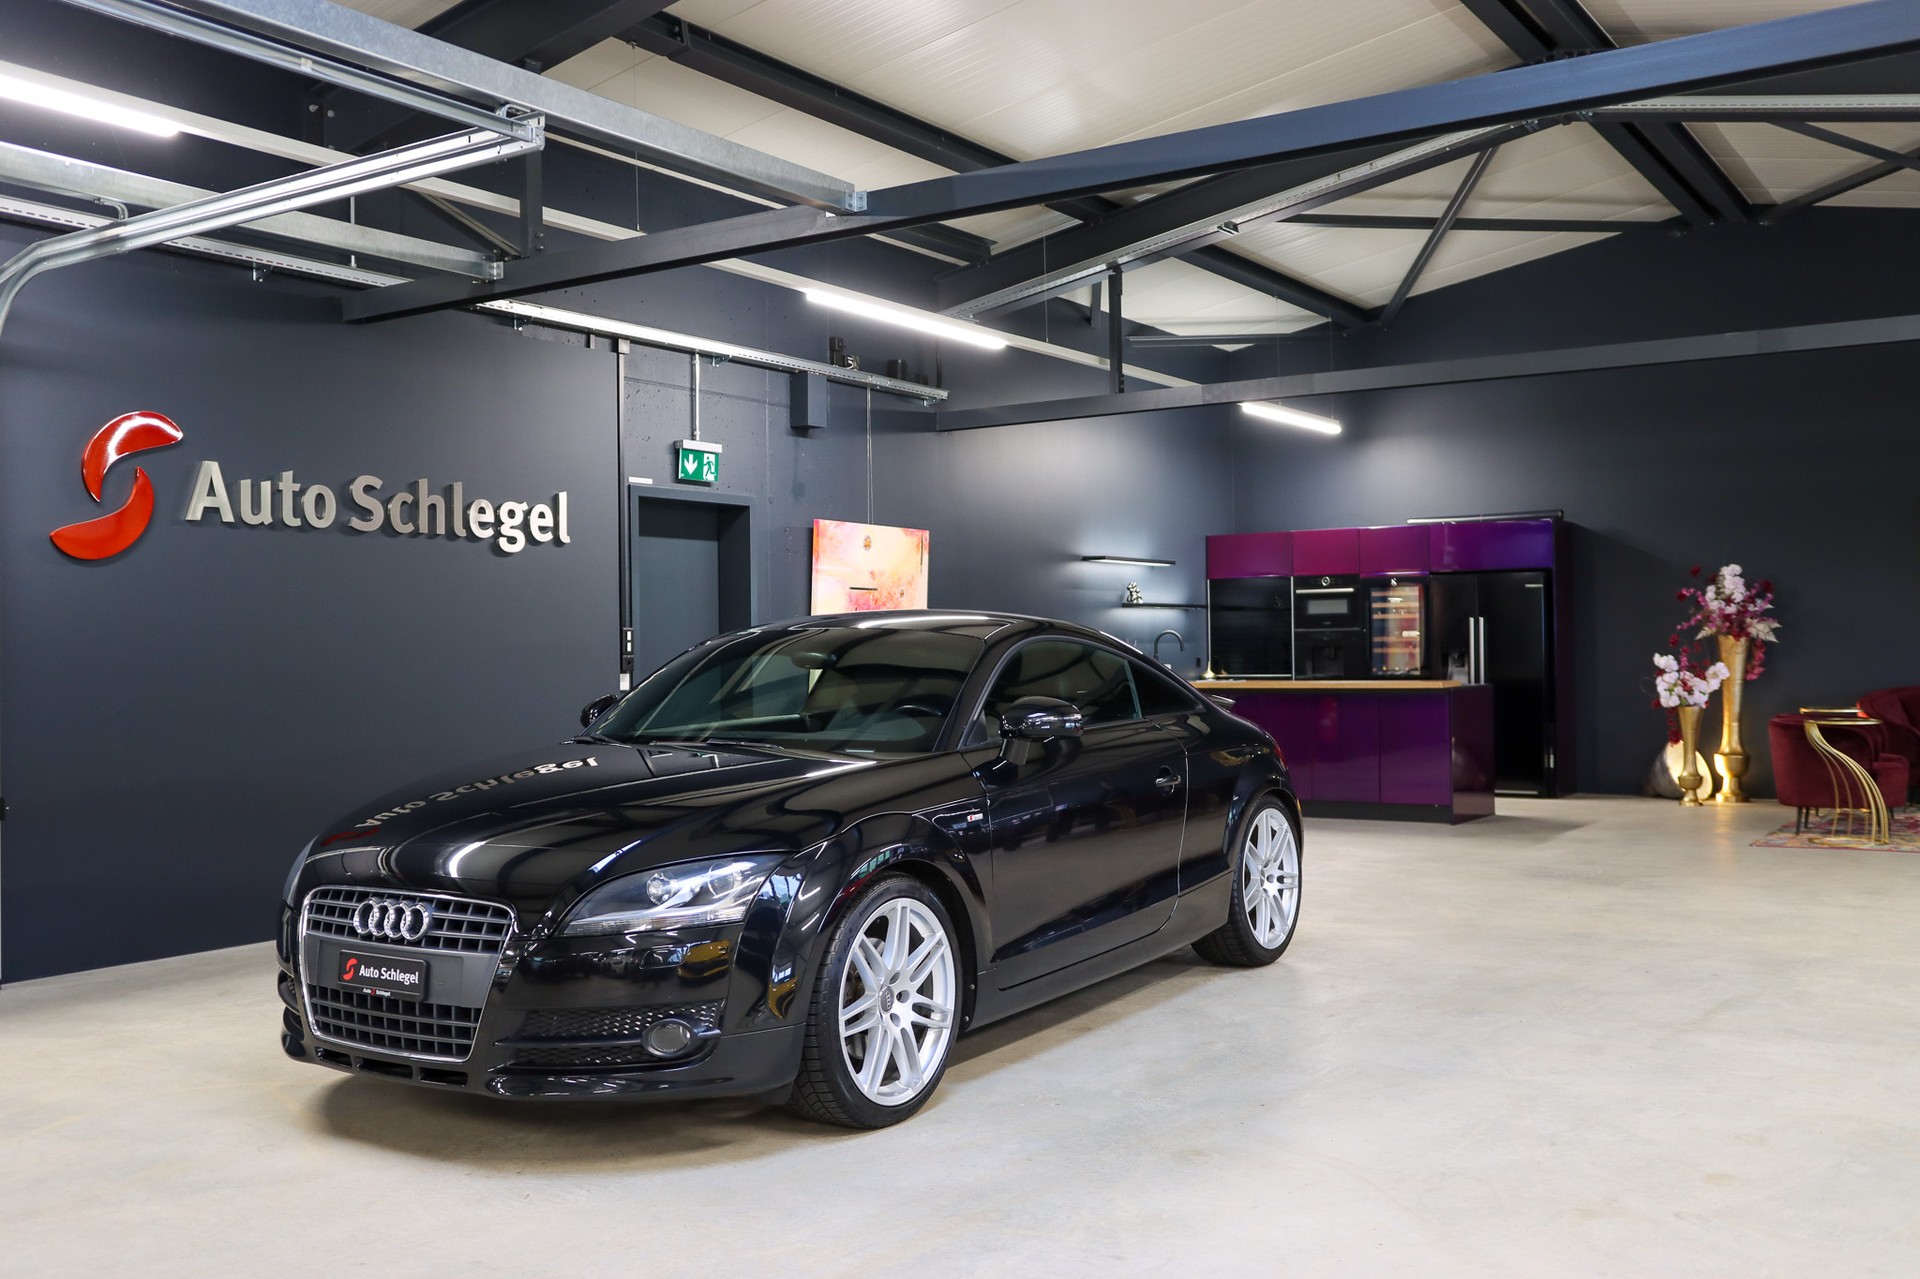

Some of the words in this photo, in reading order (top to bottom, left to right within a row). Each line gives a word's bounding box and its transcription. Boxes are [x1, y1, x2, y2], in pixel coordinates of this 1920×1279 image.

[185, 460, 336, 529] Auto
[348, 475, 571, 554] Schlegel
[359, 965, 379, 978] Auto
[381, 968, 418, 985] Schlegel
